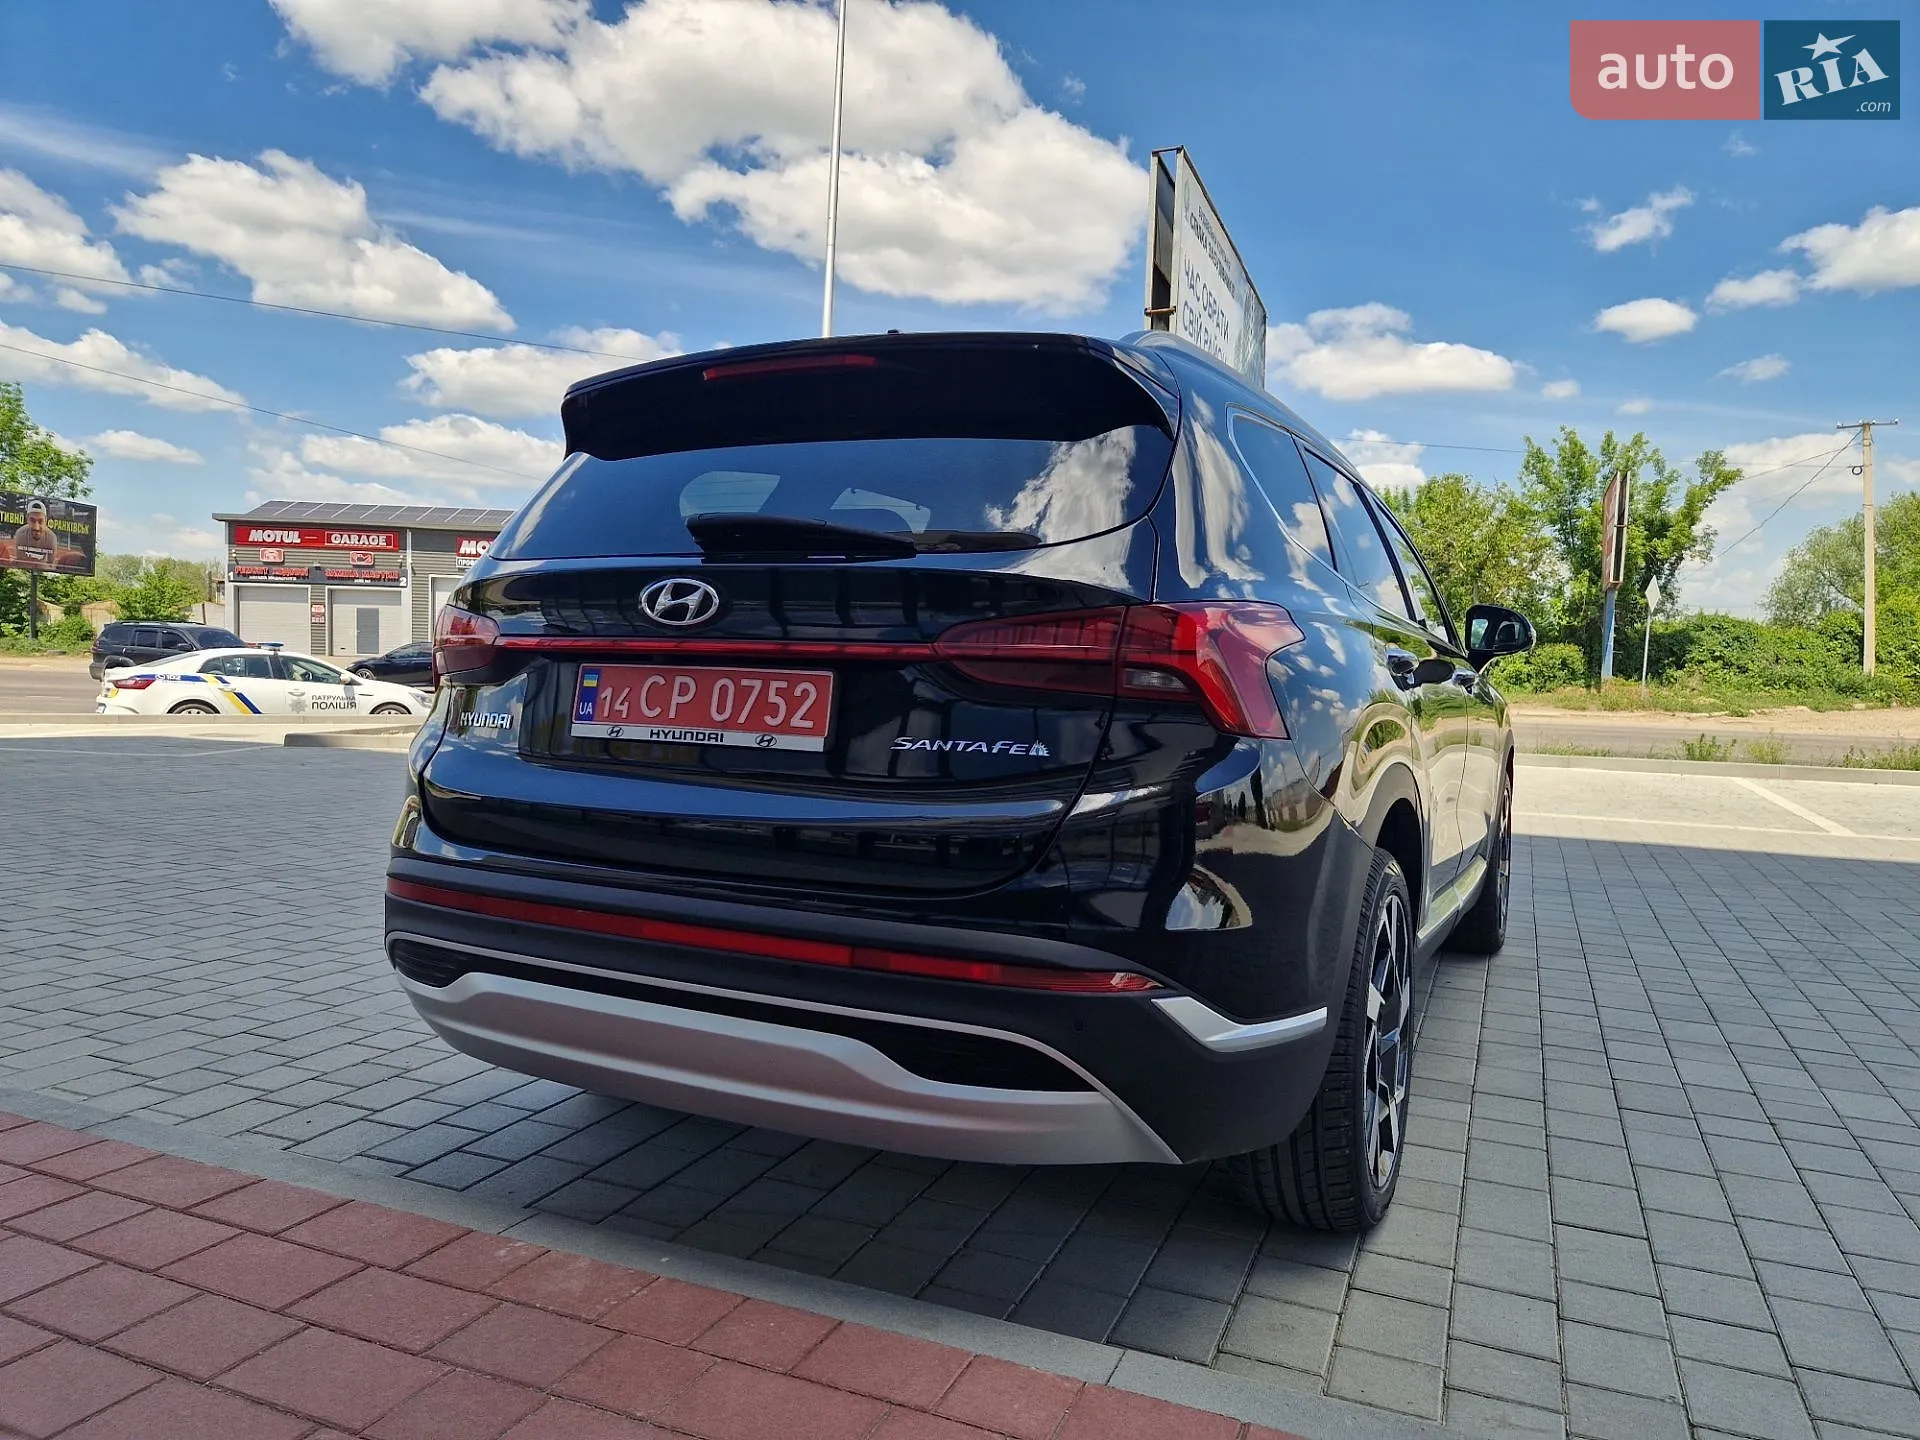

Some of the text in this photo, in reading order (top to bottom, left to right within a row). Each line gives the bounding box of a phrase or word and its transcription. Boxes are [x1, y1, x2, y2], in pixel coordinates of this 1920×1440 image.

[1184, 252, 1201, 302] ЧАС
[1202, 283, 1229, 344] ОБРАТИ
[1183, 300, 1203, 345] СВІЙ
[249, 529, 387, 546] MOTUL GARAGE
[459, 540, 492, 556] MO
[399, 577, 407, 586] 2
[311, 701, 357, 710] ПОЛІЦІЯ
[579, 701, 593, 715] UA
[600, 674, 818, 729] 14 CP 0752
[460, 711, 512, 730] HYUNDAI
[649, 728, 724, 743] HYUNDAI
